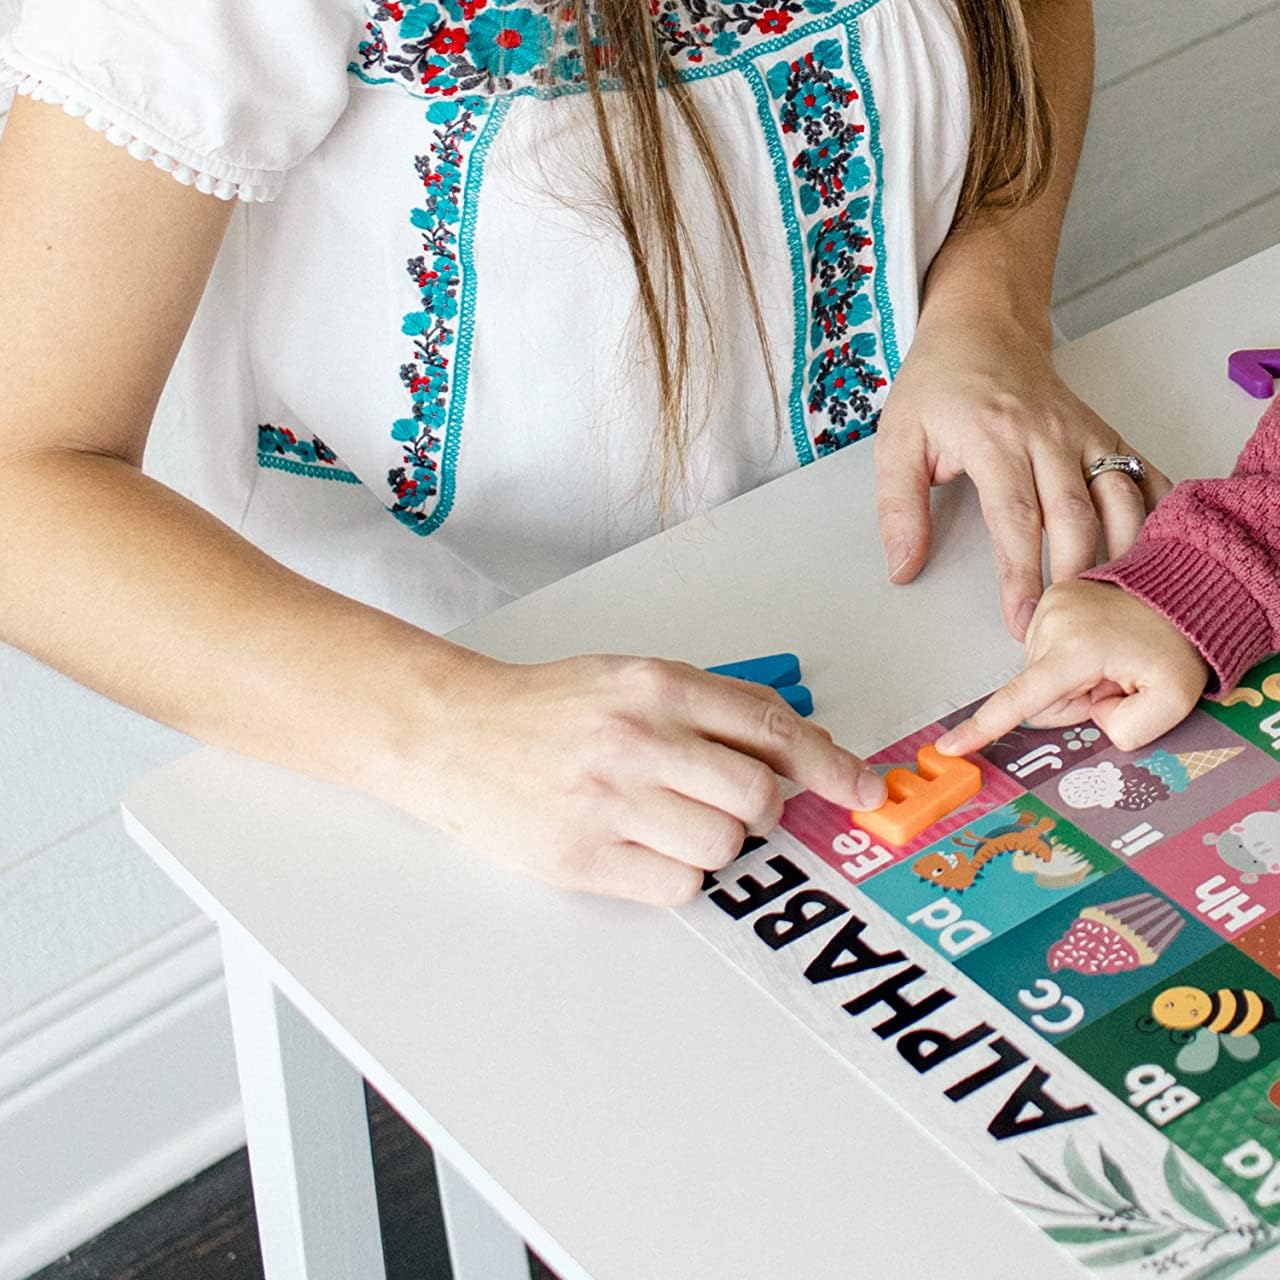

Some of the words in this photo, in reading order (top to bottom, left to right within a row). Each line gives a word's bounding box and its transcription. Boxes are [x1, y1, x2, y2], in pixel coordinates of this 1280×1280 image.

[1007, 743, 1064, 779] Jj
[853, 742, 984, 847] E
[832, 828, 894, 882] Ee
[1110, 821, 1165, 857] Ii
[906, 896, 994, 957] Dd
[1195, 873, 1267, 934] Hh
[1017, 978, 1085, 1034] Cc
[1123, 1062, 1201, 1126] Bb
